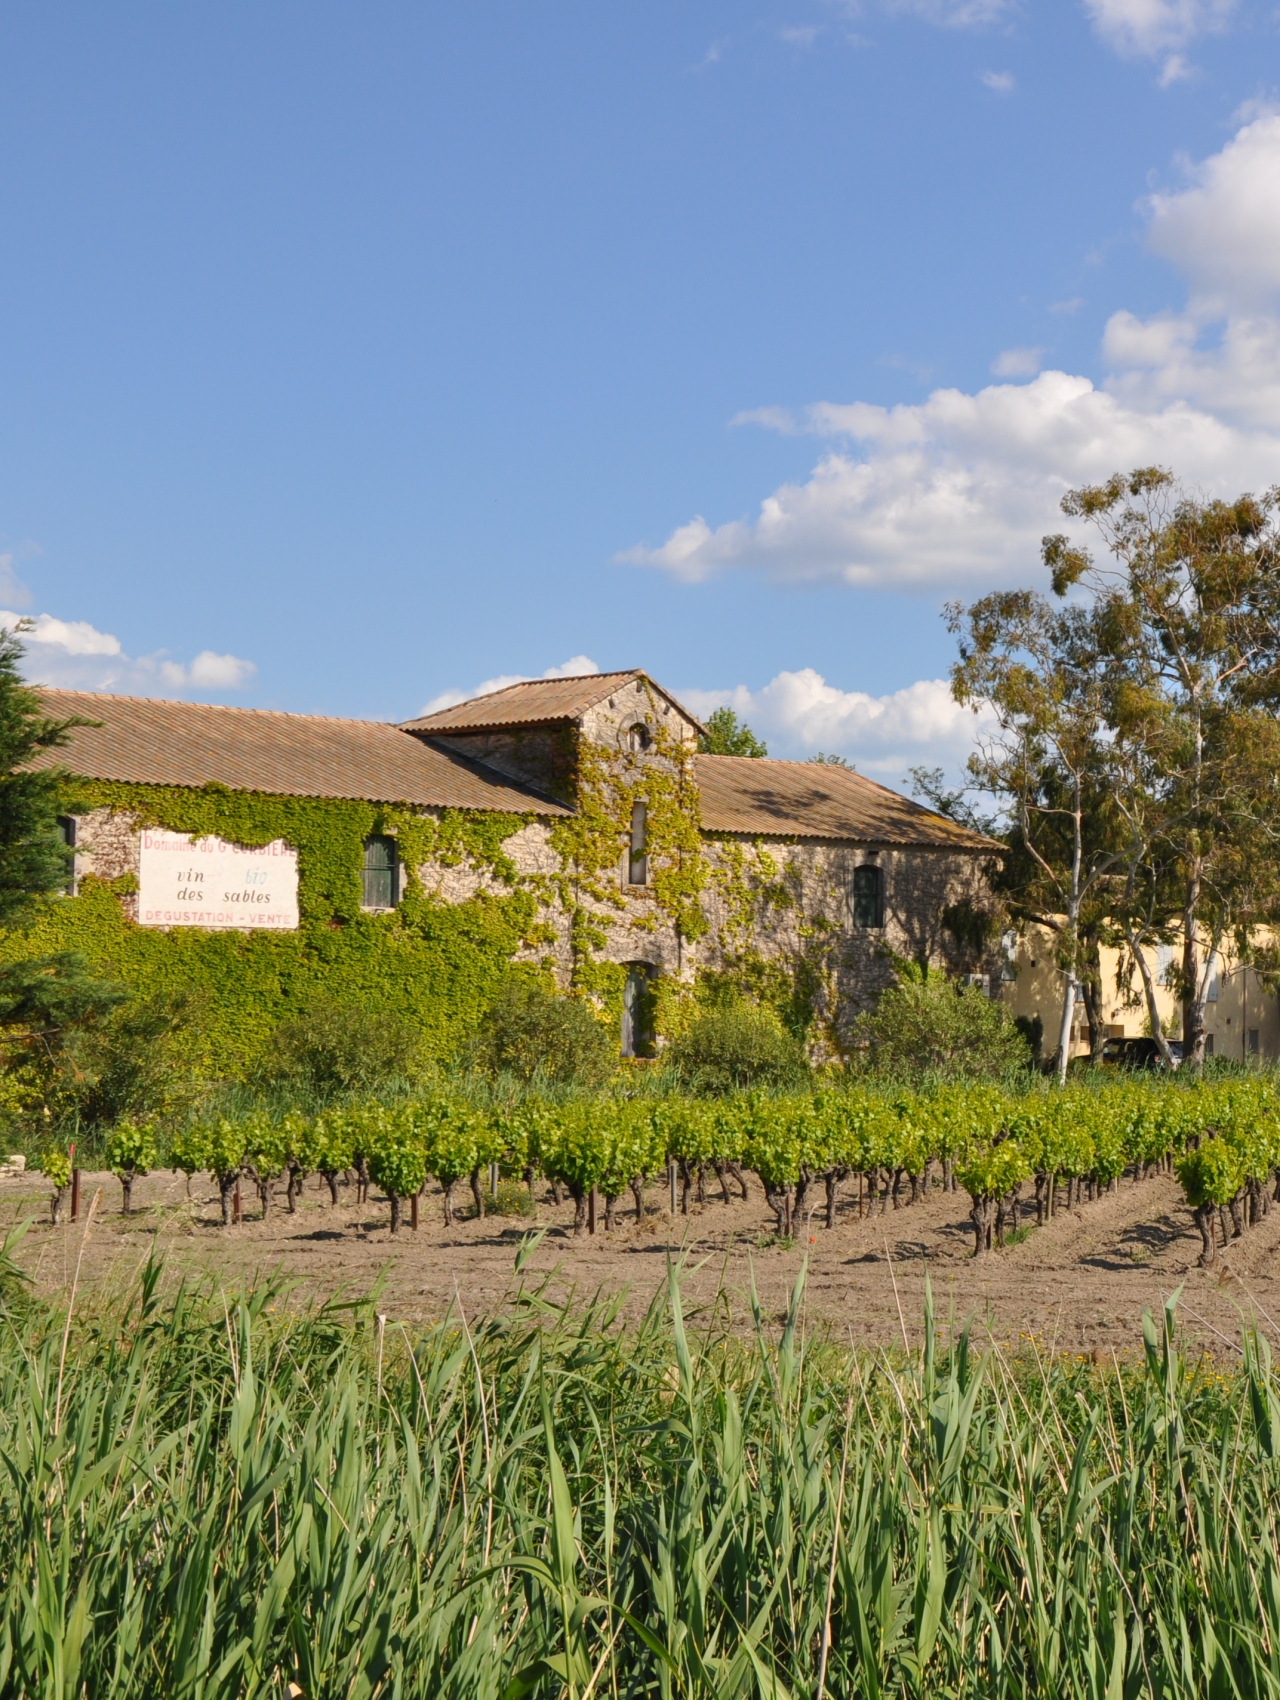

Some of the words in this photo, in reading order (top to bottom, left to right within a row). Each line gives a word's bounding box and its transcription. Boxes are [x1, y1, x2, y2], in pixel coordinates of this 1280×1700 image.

[144, 834, 196, 853] Domaine
[200, 839, 214, 853] du
[177, 868, 205, 883] vin
[245, 867, 268, 885] bio
[177, 887, 204, 901] des
[222, 889, 271, 904] sables
[145, 910, 234, 923] DEGUSTATION
[249, 913, 291, 925] VENTE
